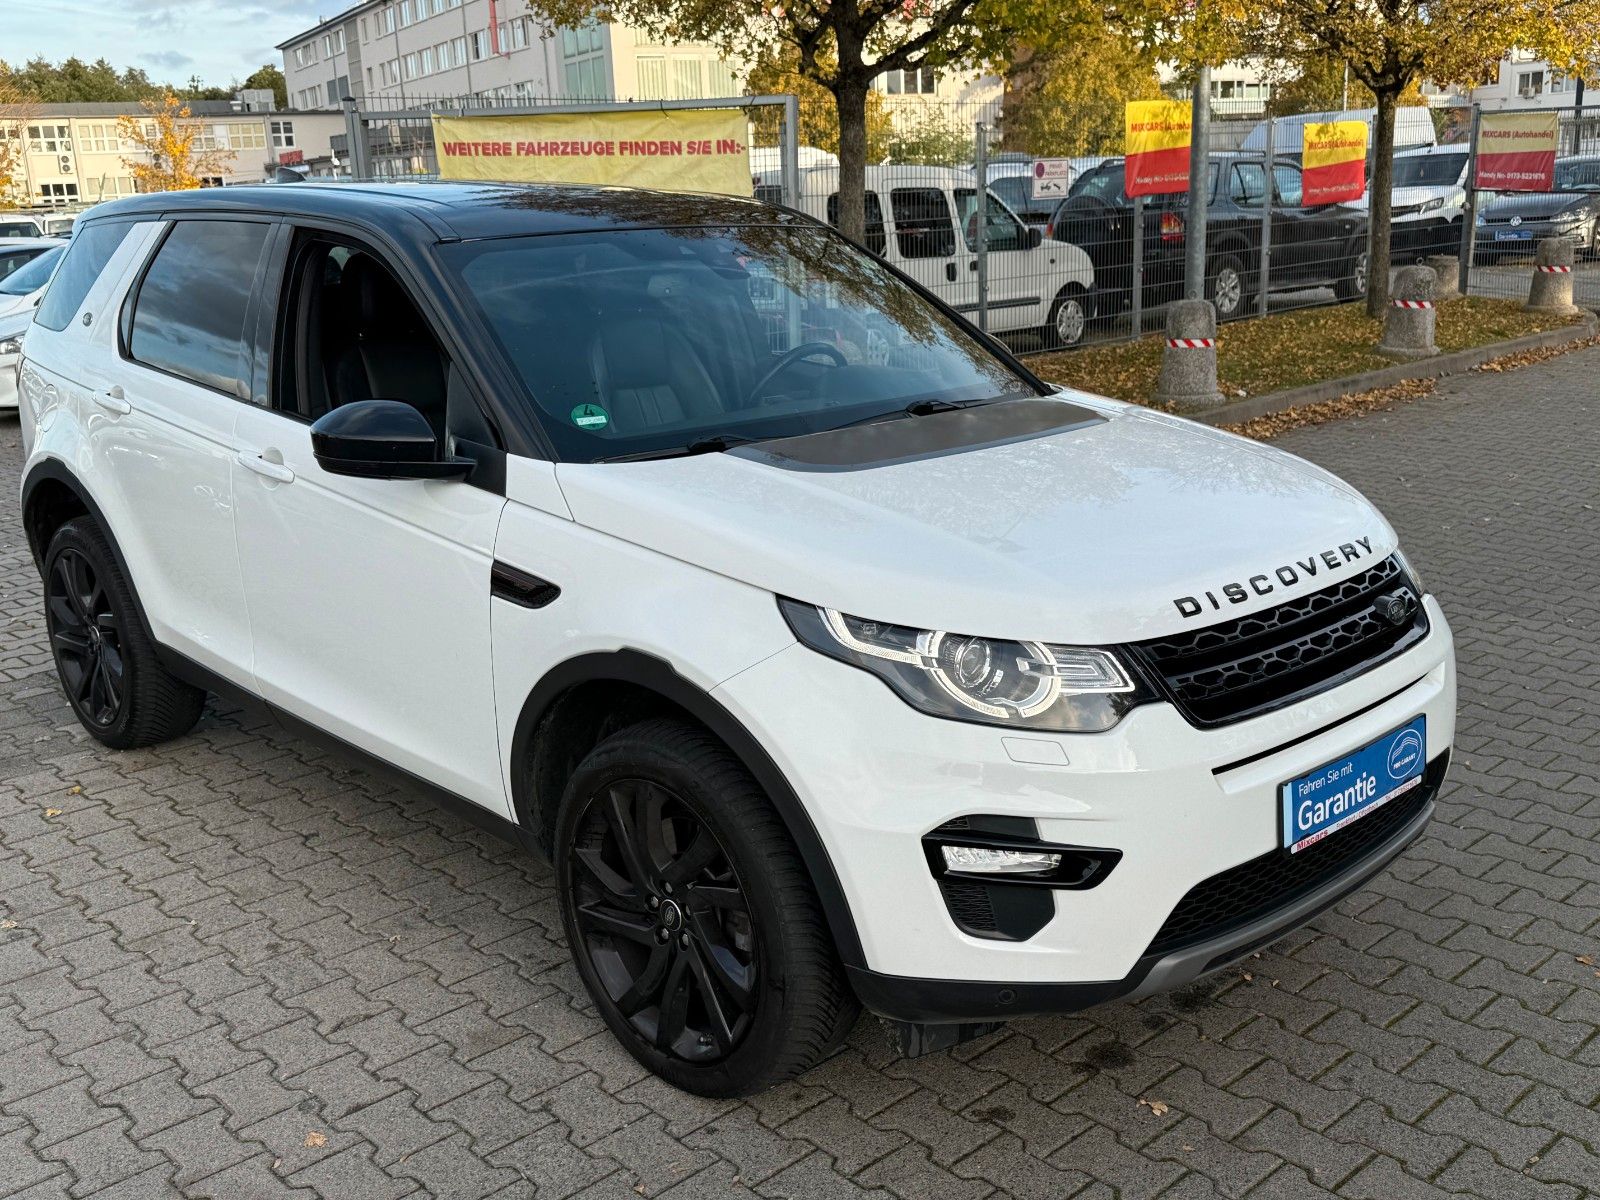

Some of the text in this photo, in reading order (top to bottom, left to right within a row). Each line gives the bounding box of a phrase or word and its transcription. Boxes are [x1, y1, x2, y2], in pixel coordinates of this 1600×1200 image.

[1512, 129, 1554, 140] (Autohandel)
[442, 141, 512, 157] WEITERE
[516, 141, 615, 157] FAHRZEUGE
[619, 140, 682, 156] FINDEN
[686, 140, 712, 155] SIE
[584, 405, 595, 416] 4
[1173, 536, 1374, 618] DISCOVERY
[1298, 762, 1353, 797] Fahren Sie mit
[1298, 772, 1376, 831] Garantie
[1296, 830, 1329, 850] Mixcars
